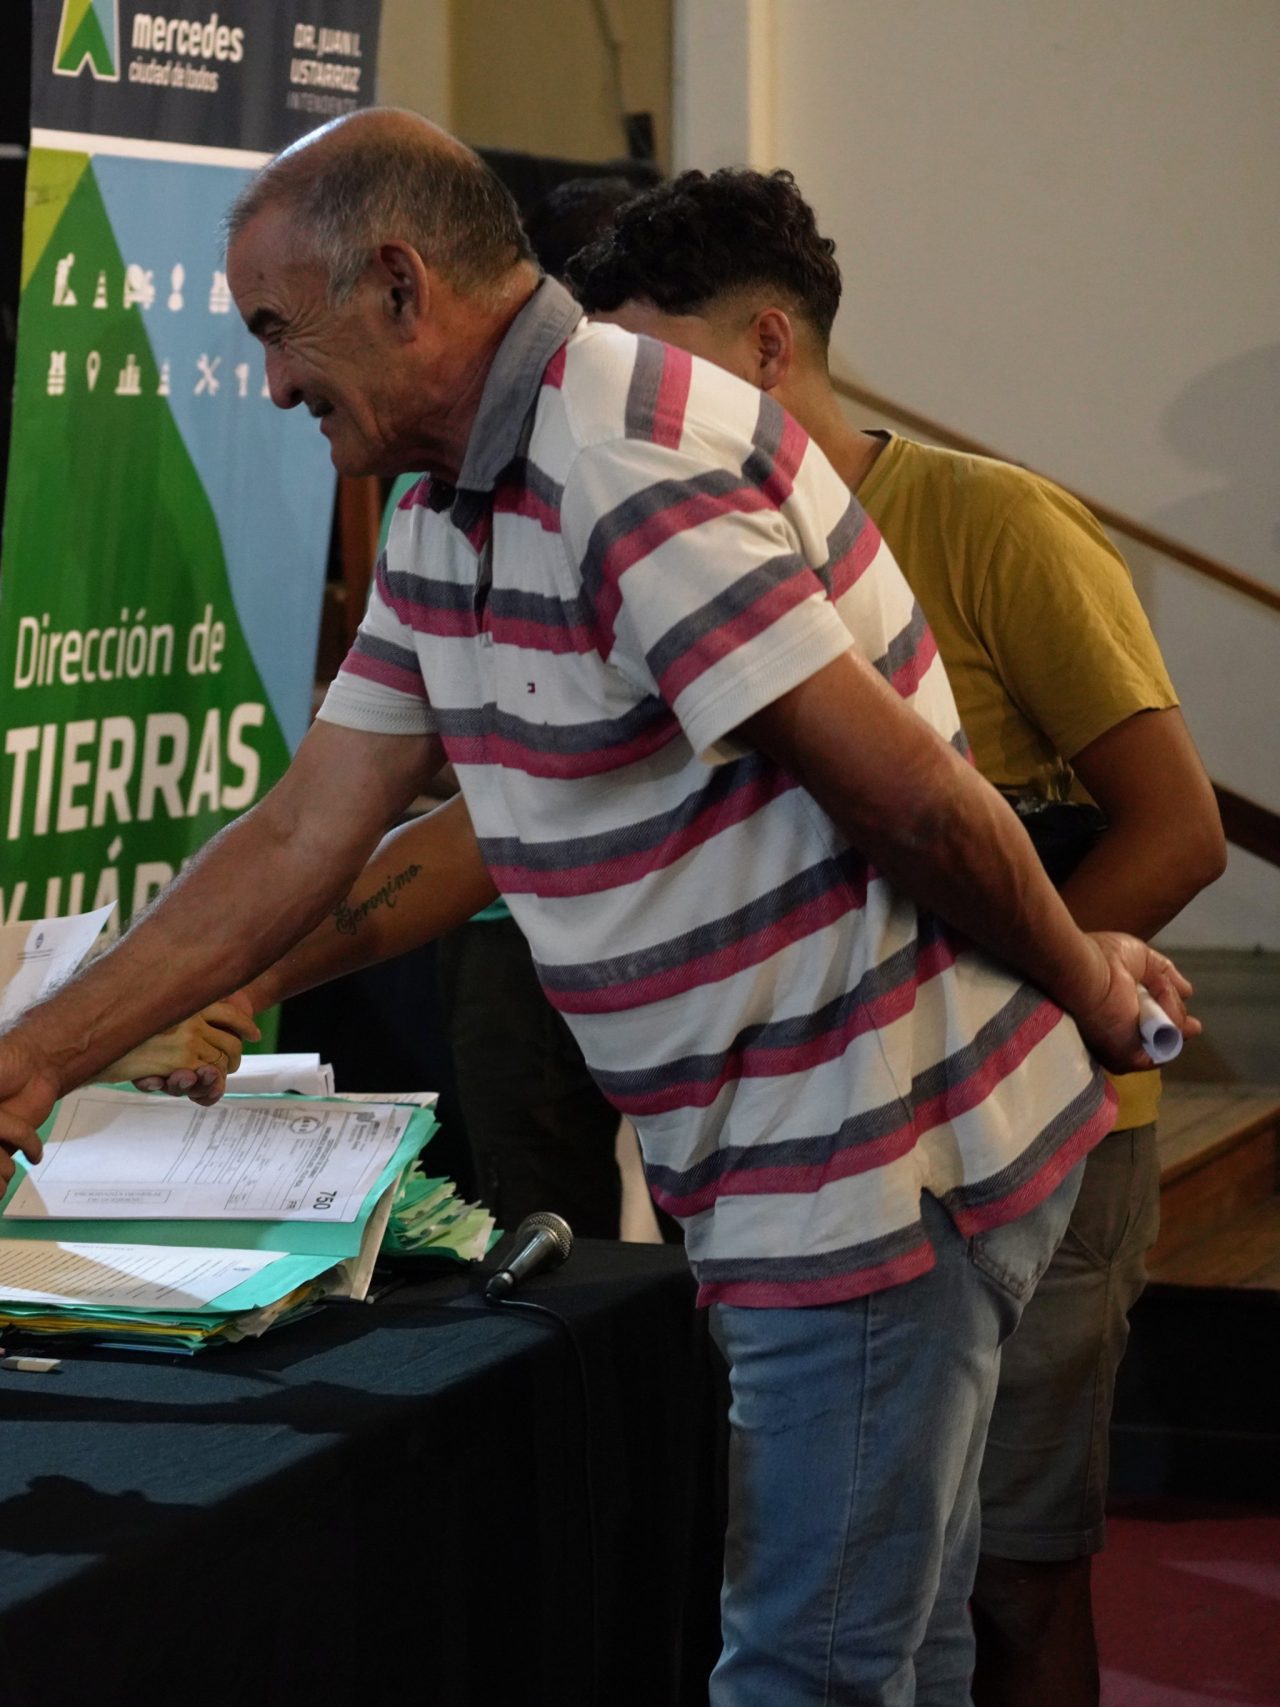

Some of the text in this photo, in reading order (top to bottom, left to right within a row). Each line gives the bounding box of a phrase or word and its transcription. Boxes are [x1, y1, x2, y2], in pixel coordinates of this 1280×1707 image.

[131, 12, 245, 63] mercedes
[293, 22, 317, 51] DR.
[128, 56, 219, 93] ciudad de todos
[13, 603, 226, 690] Dirección de
[5, 702, 266, 841] TIERRAS
[312, 1190, 338, 1210] 750
